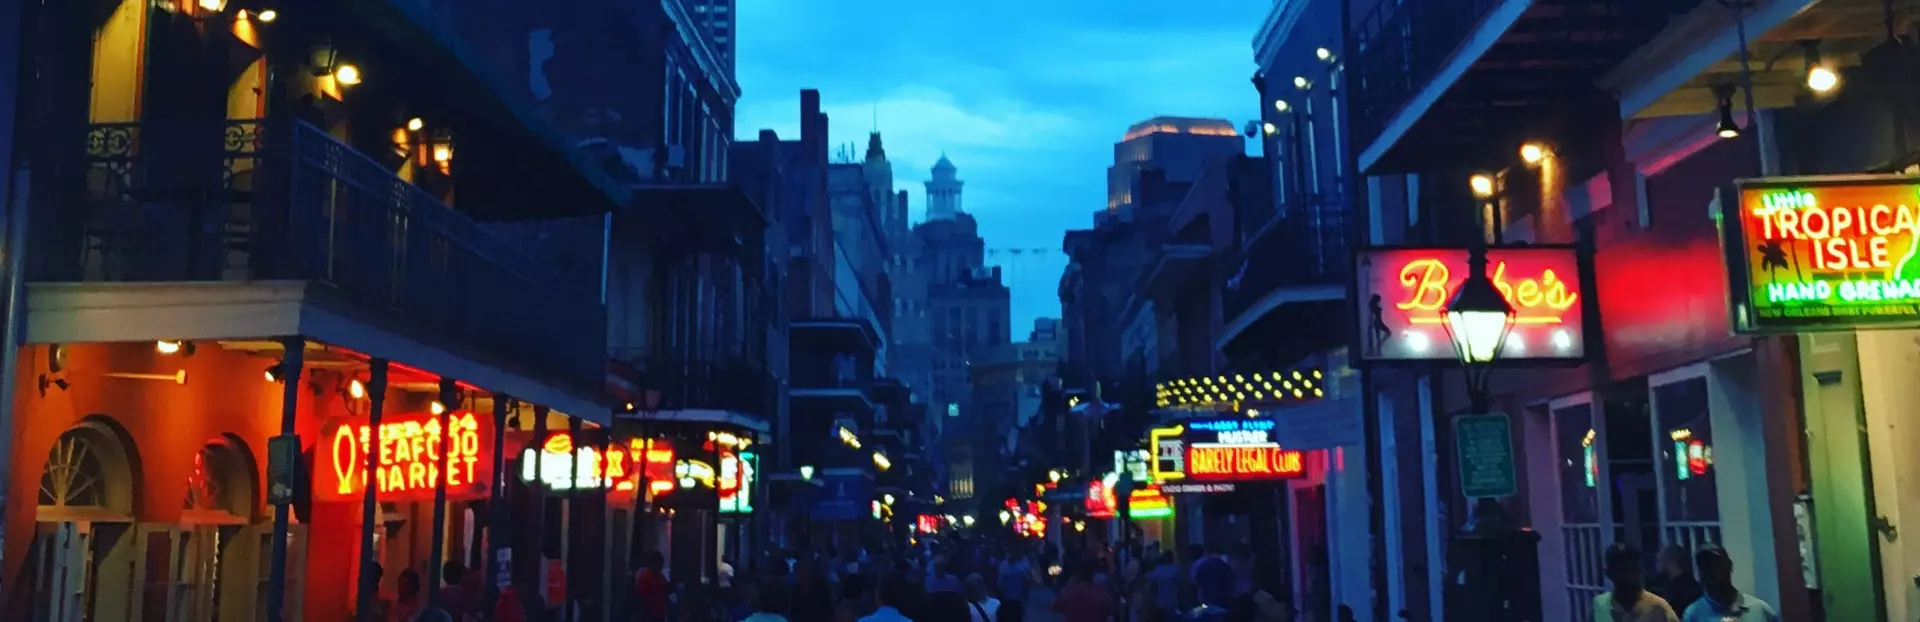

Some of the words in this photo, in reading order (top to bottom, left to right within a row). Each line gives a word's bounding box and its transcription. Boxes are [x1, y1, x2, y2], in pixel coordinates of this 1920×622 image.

[1753, 204, 1918, 239] TROPICA
[1814, 237, 1891, 269] ISLE
[1397, 259, 1577, 310] Bbe's
[1768, 280, 1831, 302] HAND
[1191, 447, 1234, 473] BARELY
[1236, 447, 1272, 473] LEGAL
